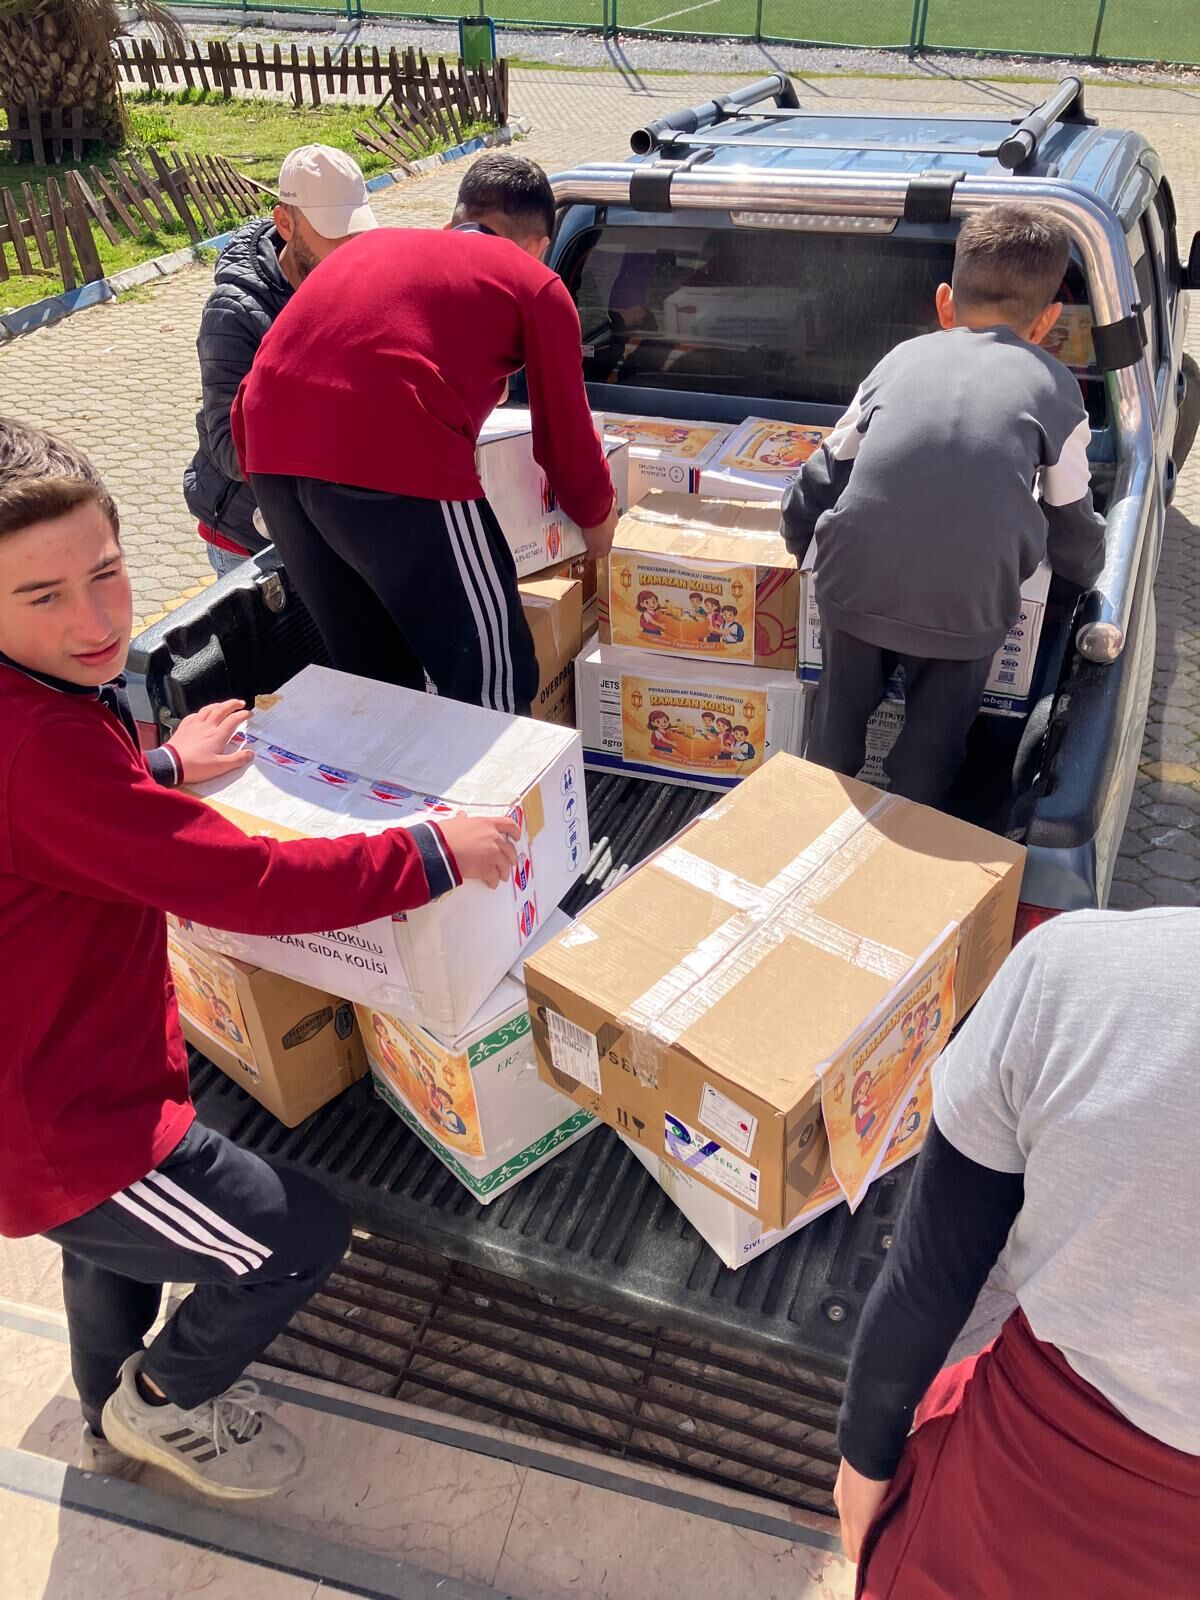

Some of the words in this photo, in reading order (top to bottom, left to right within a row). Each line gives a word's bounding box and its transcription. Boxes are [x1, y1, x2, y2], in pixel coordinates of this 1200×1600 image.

[639, 573, 688, 589] RAMAZAN
[1000, 659, 1019, 668] ISO
[650, 694, 700, 709] RAMAZAN
[308, 942, 342, 961] GIDA
[345, 952, 388, 975] KOLİSİ
